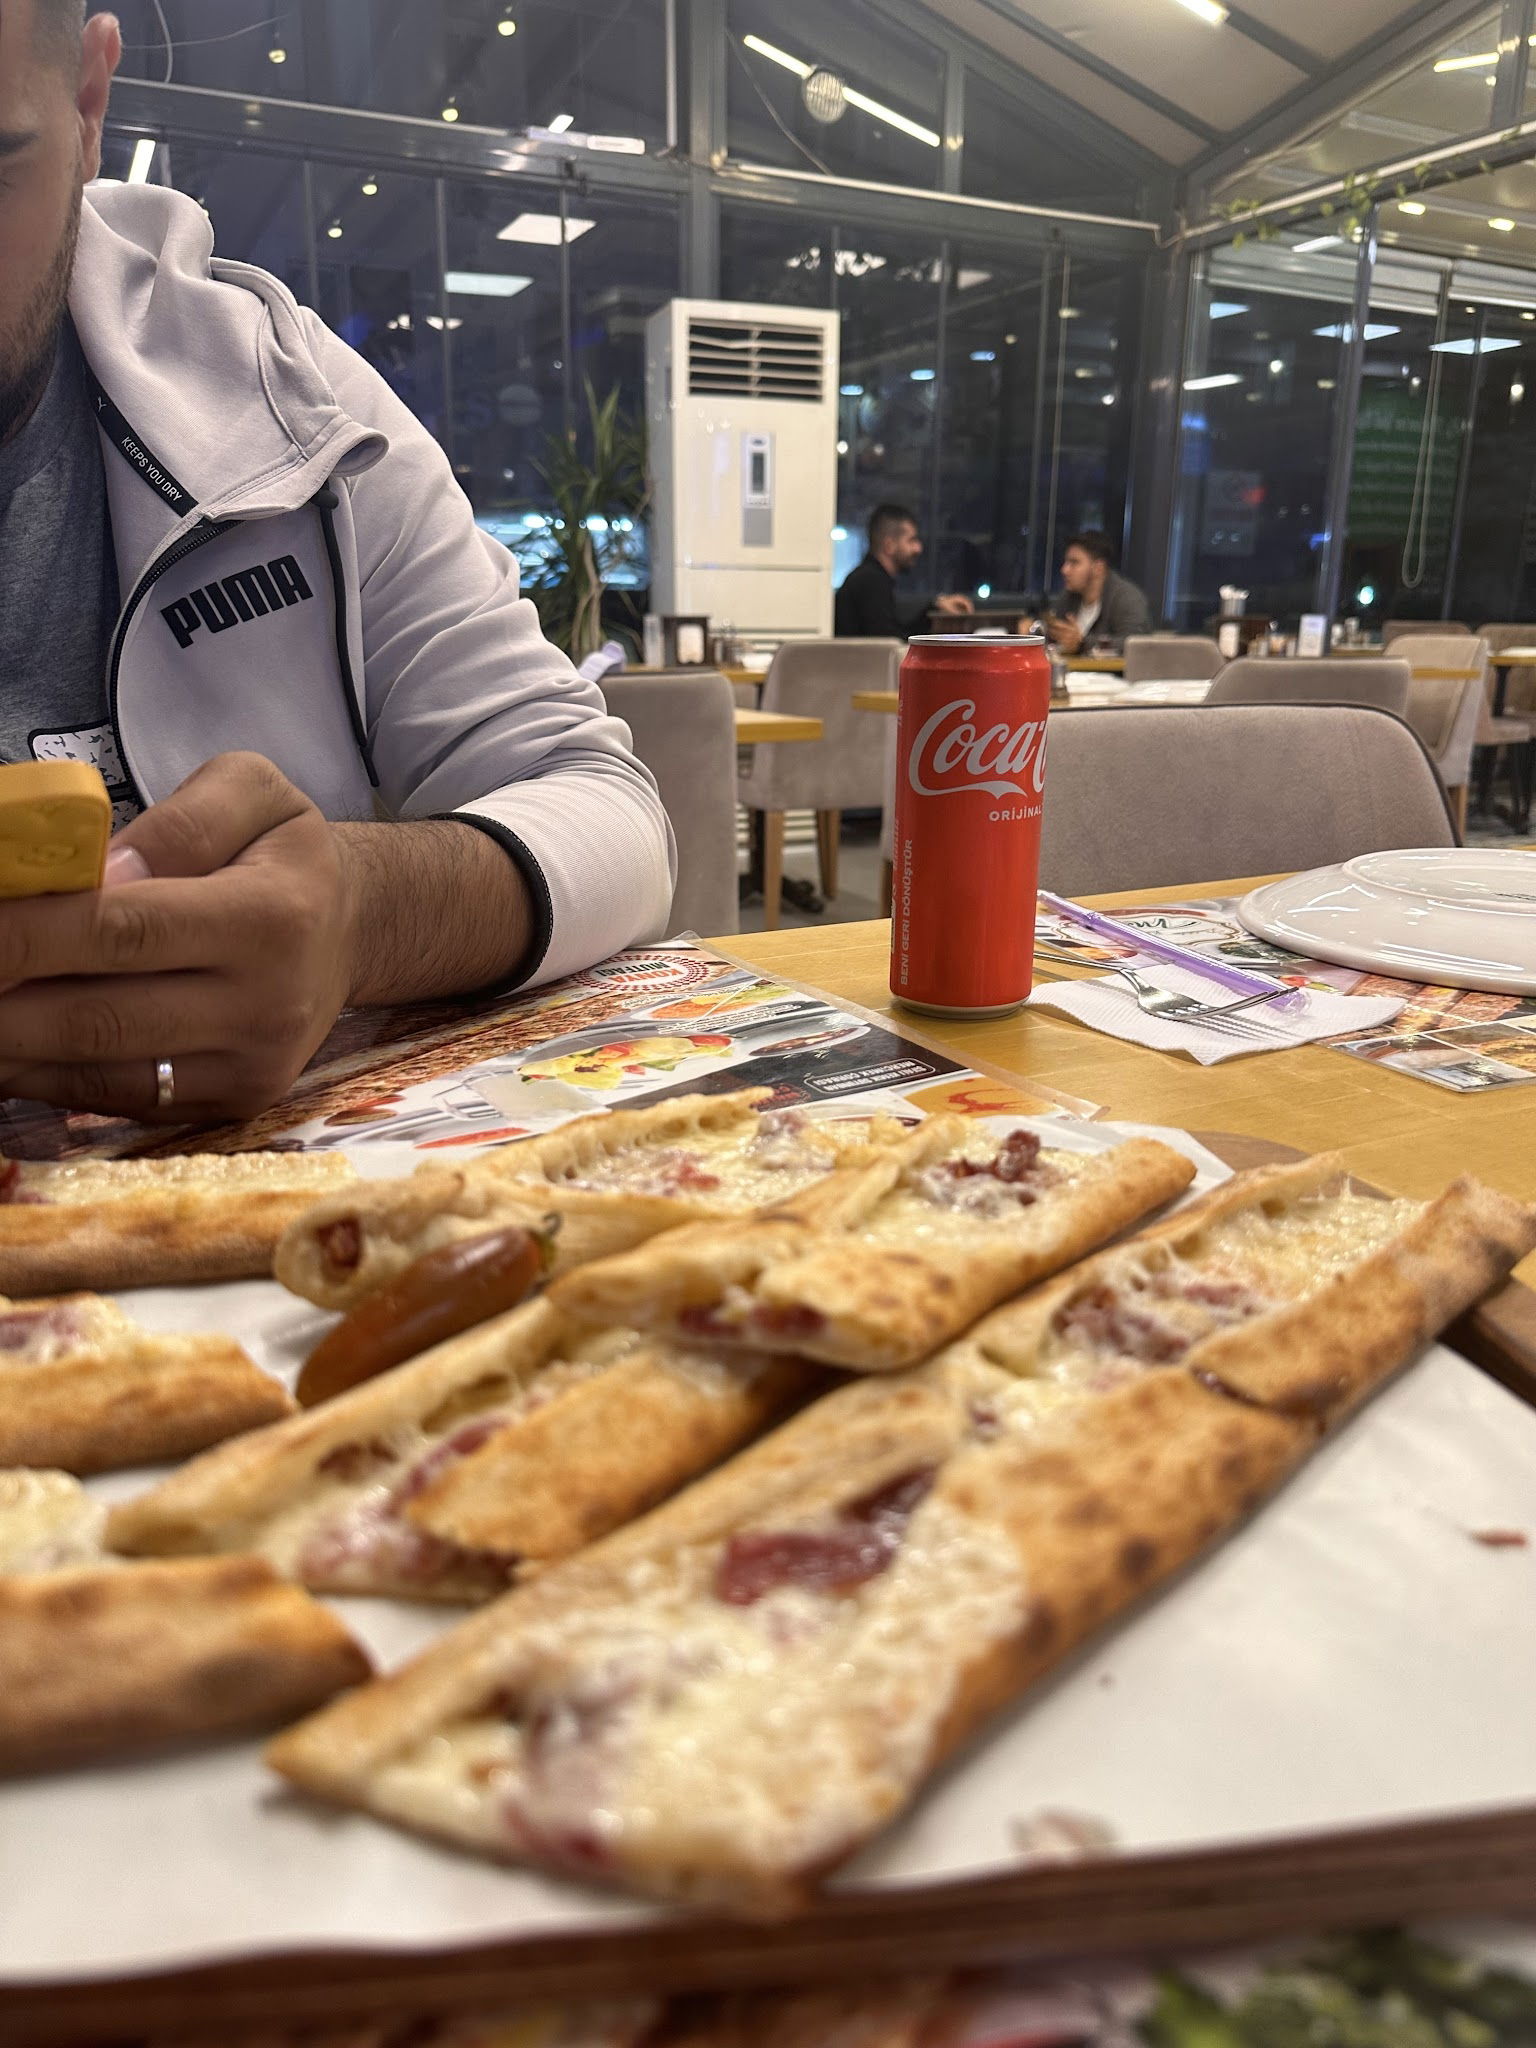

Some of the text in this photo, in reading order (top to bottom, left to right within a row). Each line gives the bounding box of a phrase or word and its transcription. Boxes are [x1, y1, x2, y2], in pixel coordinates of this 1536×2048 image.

[121, 436, 183, 501] KEEPS YOU DRY
[160, 554, 314, 649] PUMA
[607, 968, 684, 983] KONYA
